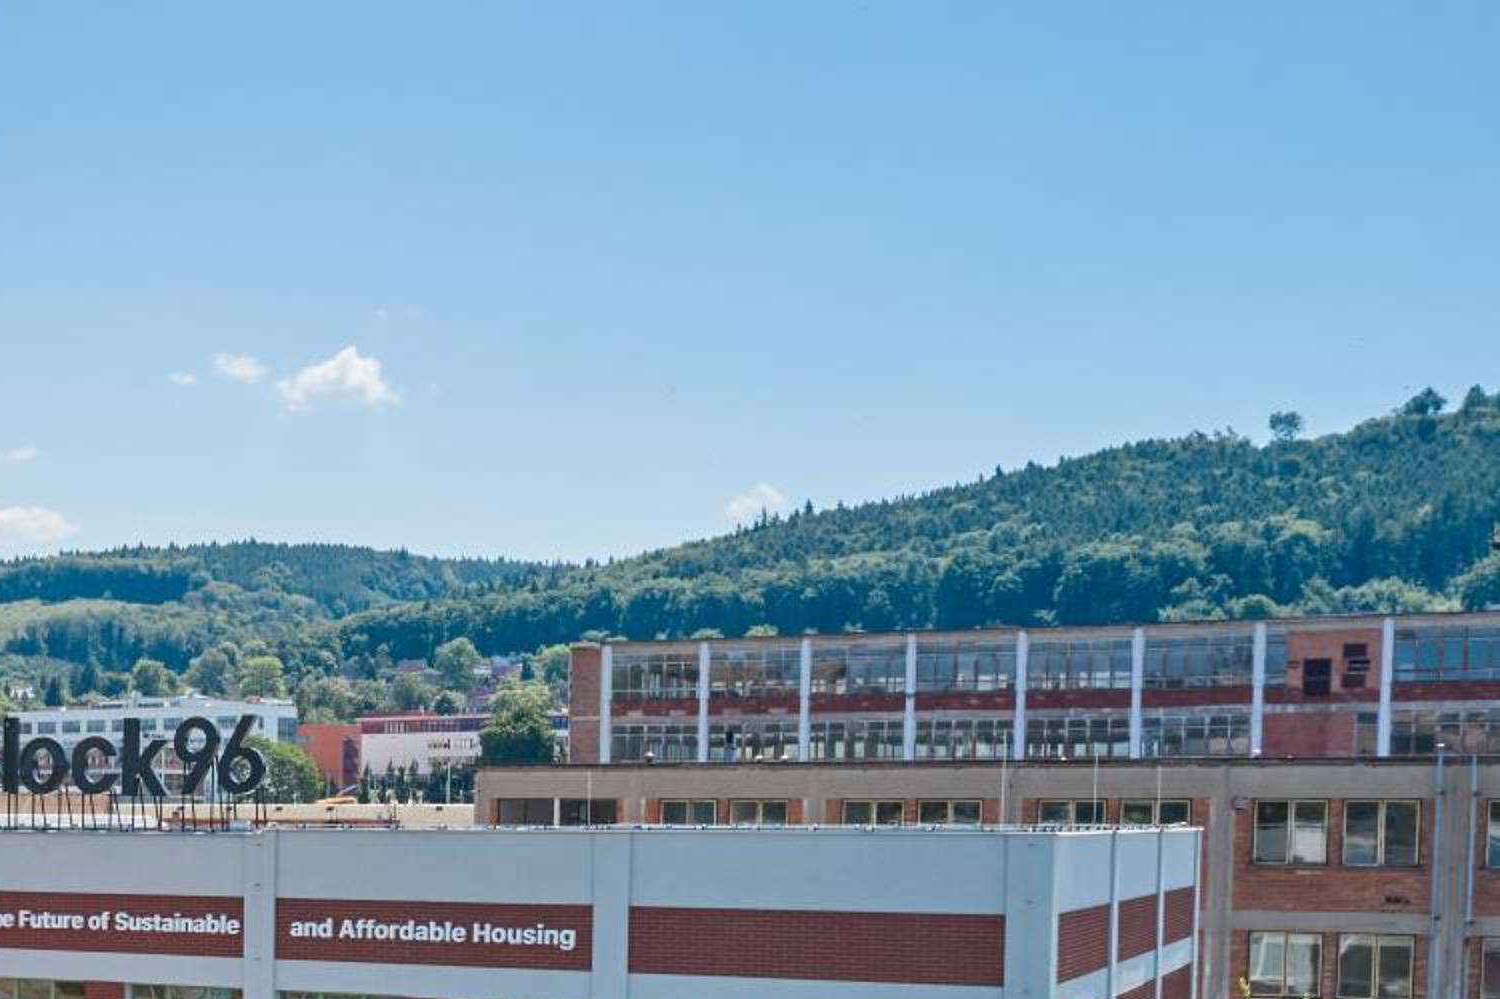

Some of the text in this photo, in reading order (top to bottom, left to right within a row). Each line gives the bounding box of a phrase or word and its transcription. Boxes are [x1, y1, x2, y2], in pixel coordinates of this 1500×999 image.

[18, 910, 83, 930] Future
[88, 911, 110, 931] of
[114, 912, 241, 935] Sustainable
[290, 917, 576, 951] and Affordable Housing
